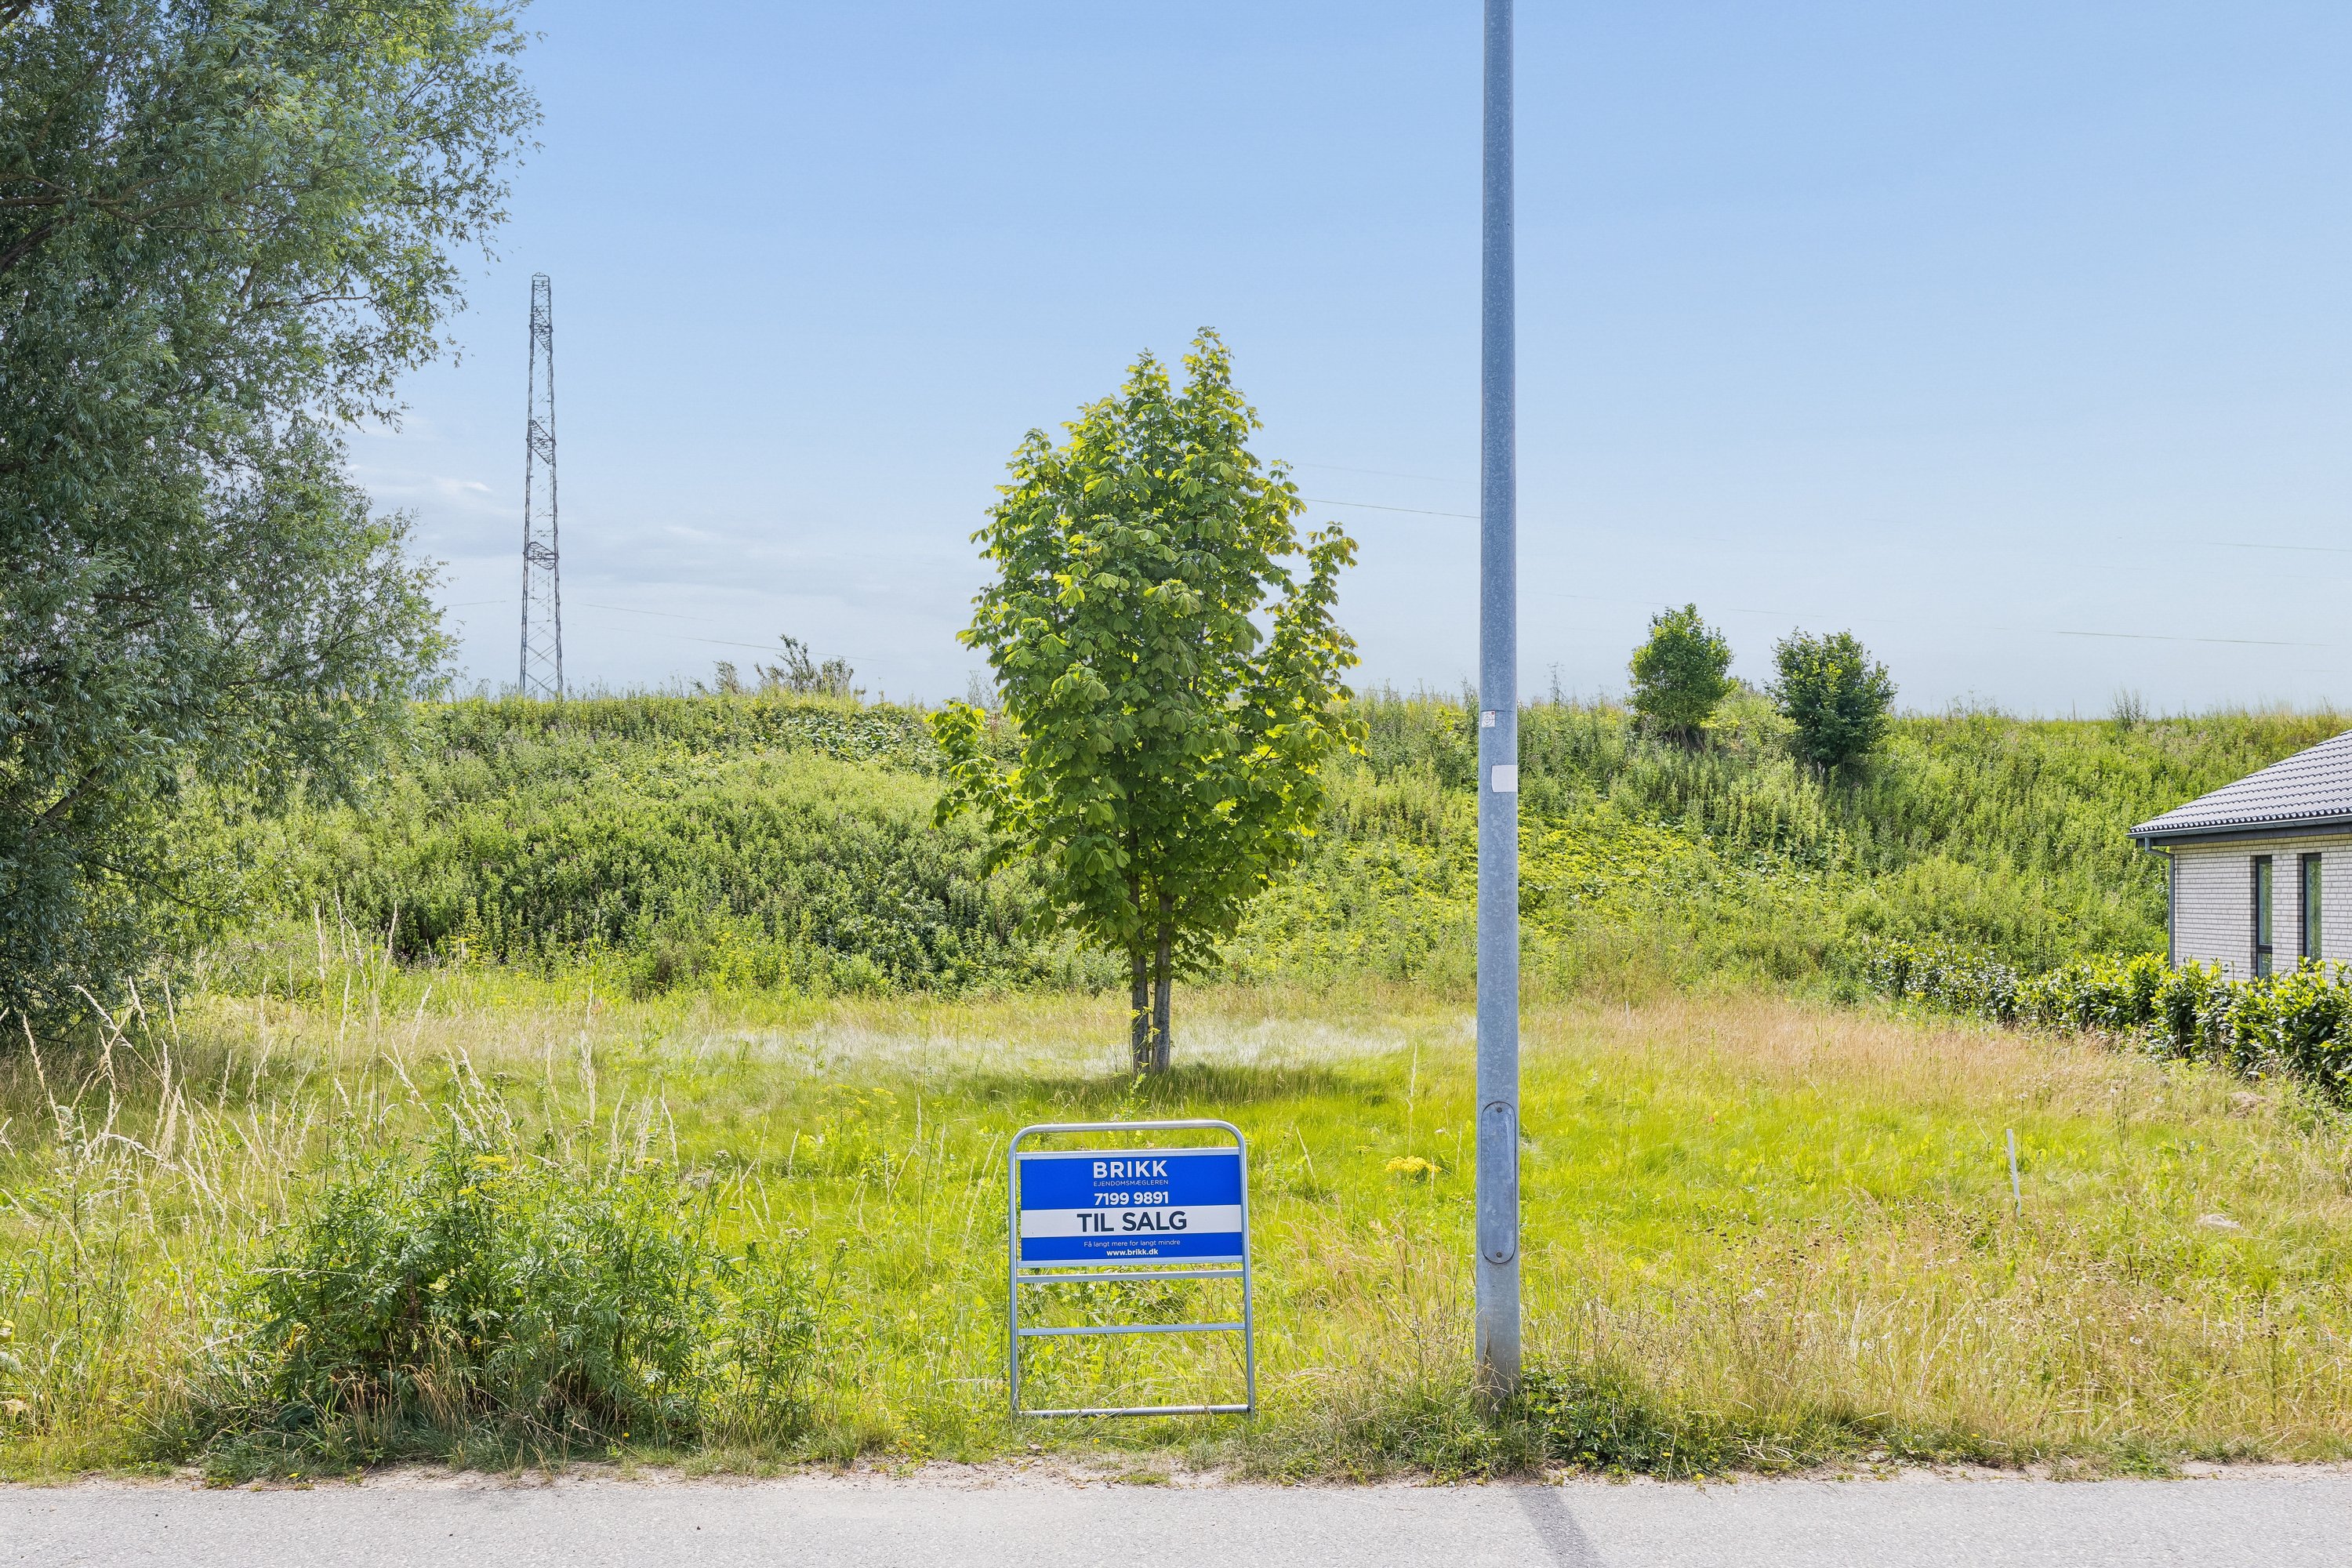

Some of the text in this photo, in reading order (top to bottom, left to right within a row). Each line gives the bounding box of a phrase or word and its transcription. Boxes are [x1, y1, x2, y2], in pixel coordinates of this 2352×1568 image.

[1093, 1160, 1168, 1178] BRIKK
[1094, 1192, 1169, 1206] 7199 9891
[1076, 1210, 1187, 1232] TIL SALG
